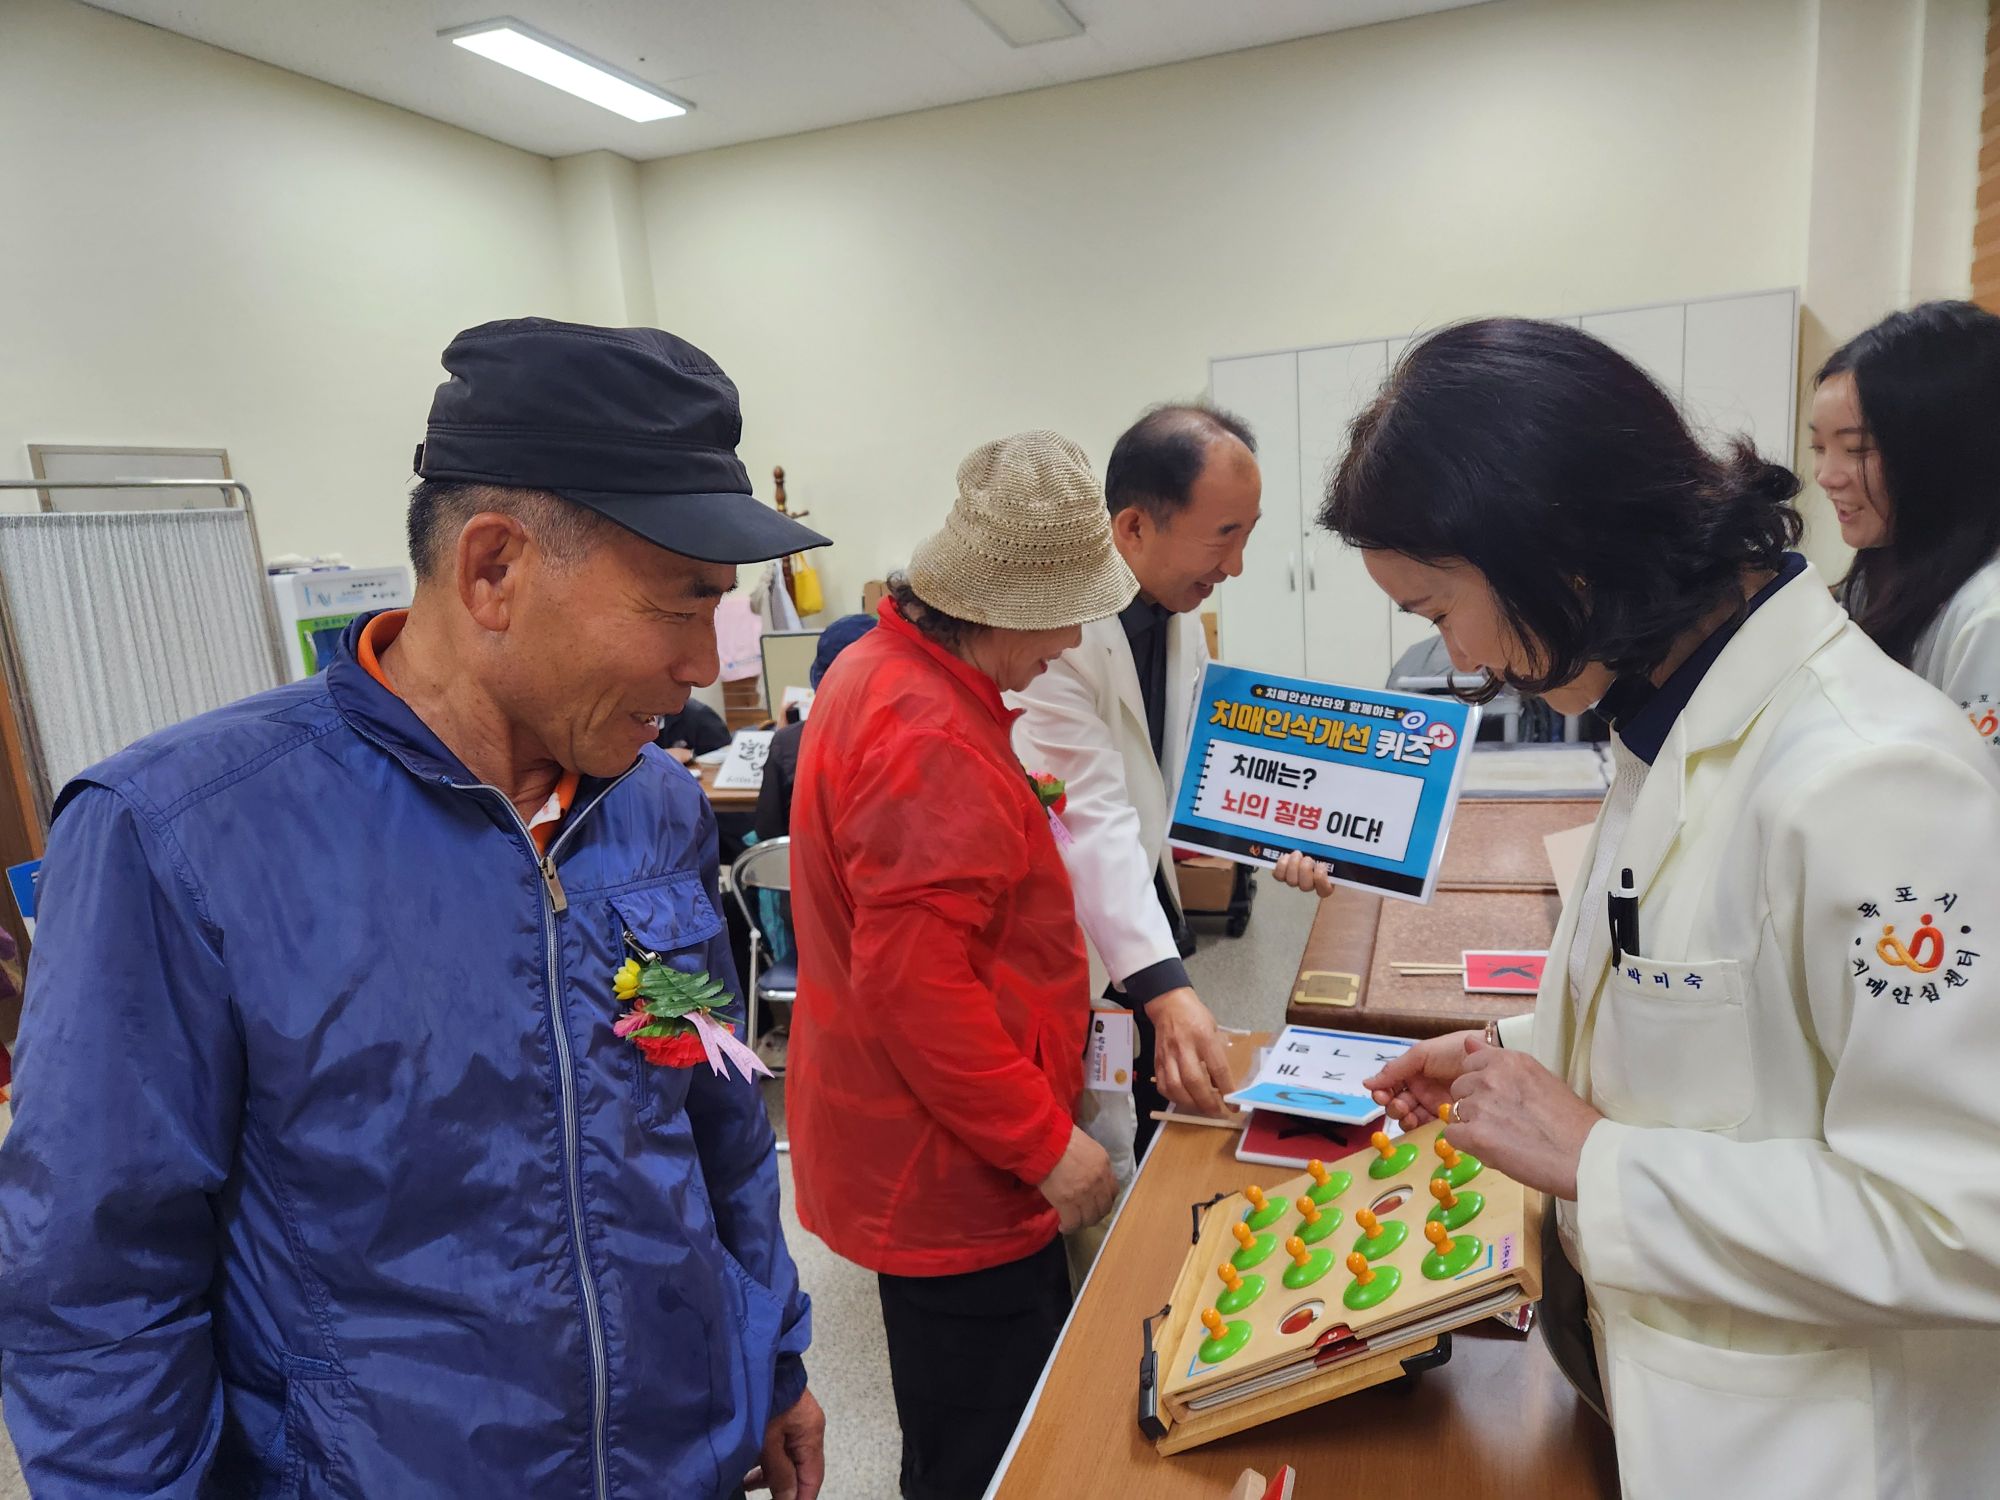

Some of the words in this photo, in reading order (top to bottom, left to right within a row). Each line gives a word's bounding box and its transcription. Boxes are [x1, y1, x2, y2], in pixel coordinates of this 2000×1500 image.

[1265, 687, 1345, 711] 치매안심산타와
[1349, 701, 1396, 719] 함께하는
[1209, 700, 1372, 754] 치매인식개선
[1375, 729, 1435, 765] 퀴즈
[1230, 754, 1317, 790] 치매는?
[1221, 789, 1269, 819] 뇌의
[1274, 799, 1322, 831] 질병
[1326, 811, 1384, 843] 이다!
[1857, 886, 1958, 918] 목포시
[1627, 967, 1704, 990] 박미숙
[1853, 949, 1981, 1005] 치매안심센터
